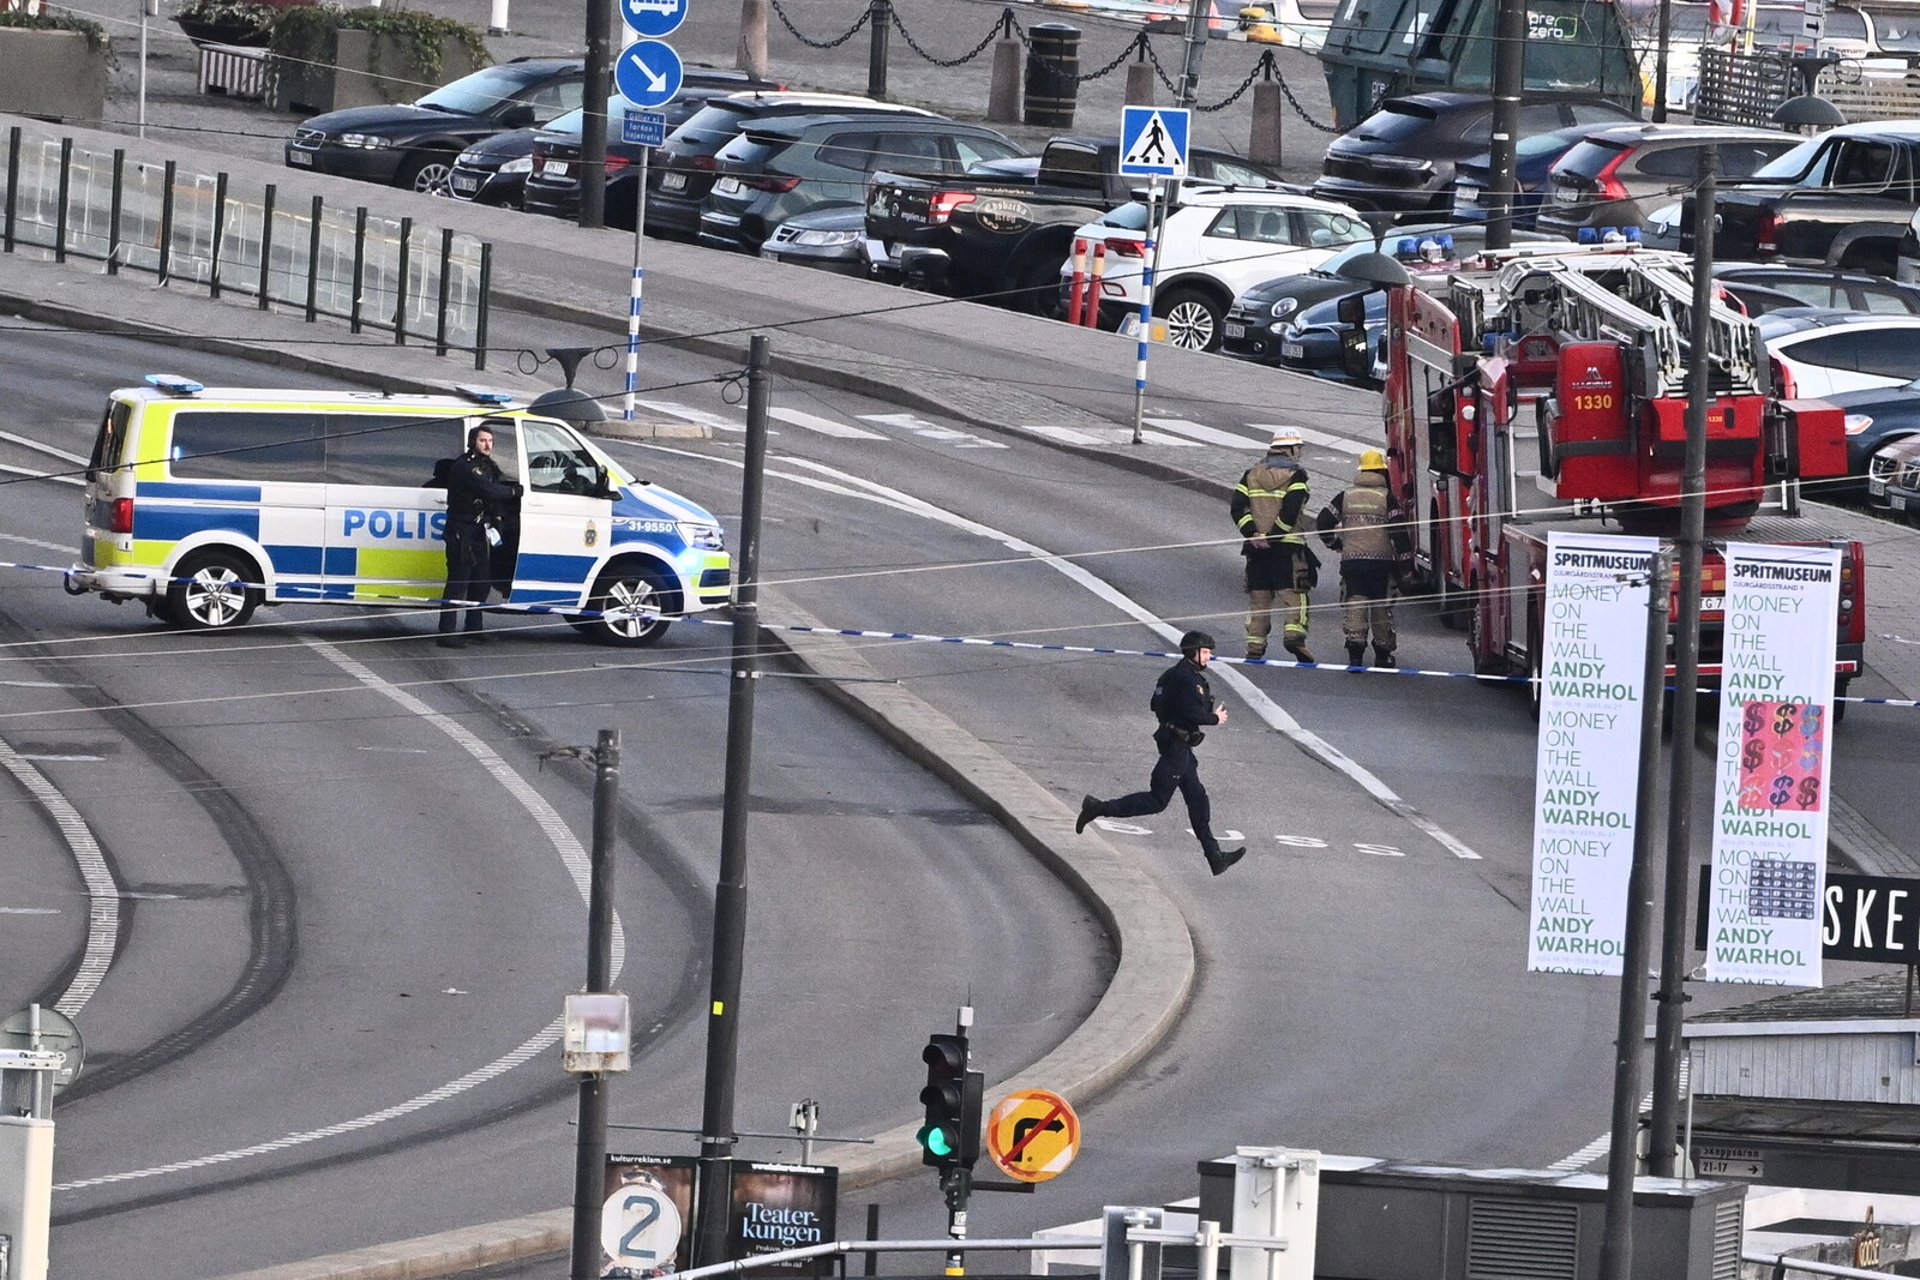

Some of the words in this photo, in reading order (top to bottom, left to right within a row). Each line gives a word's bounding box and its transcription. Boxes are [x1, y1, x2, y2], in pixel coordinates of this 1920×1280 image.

[1529, 25, 1563, 39] zero
[1574, 394, 1613, 410] 1330
[343, 510, 448, 541] POLIS
[628, 520, 673, 533] 31-9550
[1554, 553, 1651, 571] SPRITMUSEUM
[1733, 564, 1832, 583] SPRITMUSEUM
[1553, 583, 1624, 602] MONEY
[1553, 602, 1581, 619] ON
[1732, 594, 1803, 614] MONEY
[1551, 621, 1588, 639] THE
[1731, 613, 1760, 631] ON
[1730, 632, 1767, 650] THE
[1550, 641, 1603, 660] WALL
[1550, 661, 1606, 679] ANDY
[1730, 653, 1782, 671] WALL
[1728, 672, 1785, 690] ANDY
[1549, 681, 1638, 701] WARHOL
[1547, 710, 1618, 729] MONEY
[1546, 729, 1575, 746] ON
[1545, 749, 1582, 767] THE
[1544, 769, 1597, 787] WALL
[1543, 788, 1600, 807] ANDY
[1542, 808, 1632, 829] WARHOL
[1721, 819, 1811, 839] WARHOL
[1541, 838, 1611, 858] MONEY
[1540, 857, 1569, 874] ON
[1538, 877, 1575, 894] THE
[1719, 868, 1748, 885] ON
[1538, 897, 1591, 915] WALL
[1537, 916, 1594, 934] ANDY
[1822, 885, 1920, 951] SKE
[1716, 927, 1773, 945] ANDY
[1536, 936, 1625, 956] WARHOL
[1716, 947, 1806, 966] WARHOL
[610, 1154, 672, 1164] kulturreklam.se
[1703, 1162, 1728, 1173] 21-17
[745, 1202, 820, 1226] Teater-
[619, 1195, 661, 1259] 2
[742, 1216, 821, 1247] kungen
